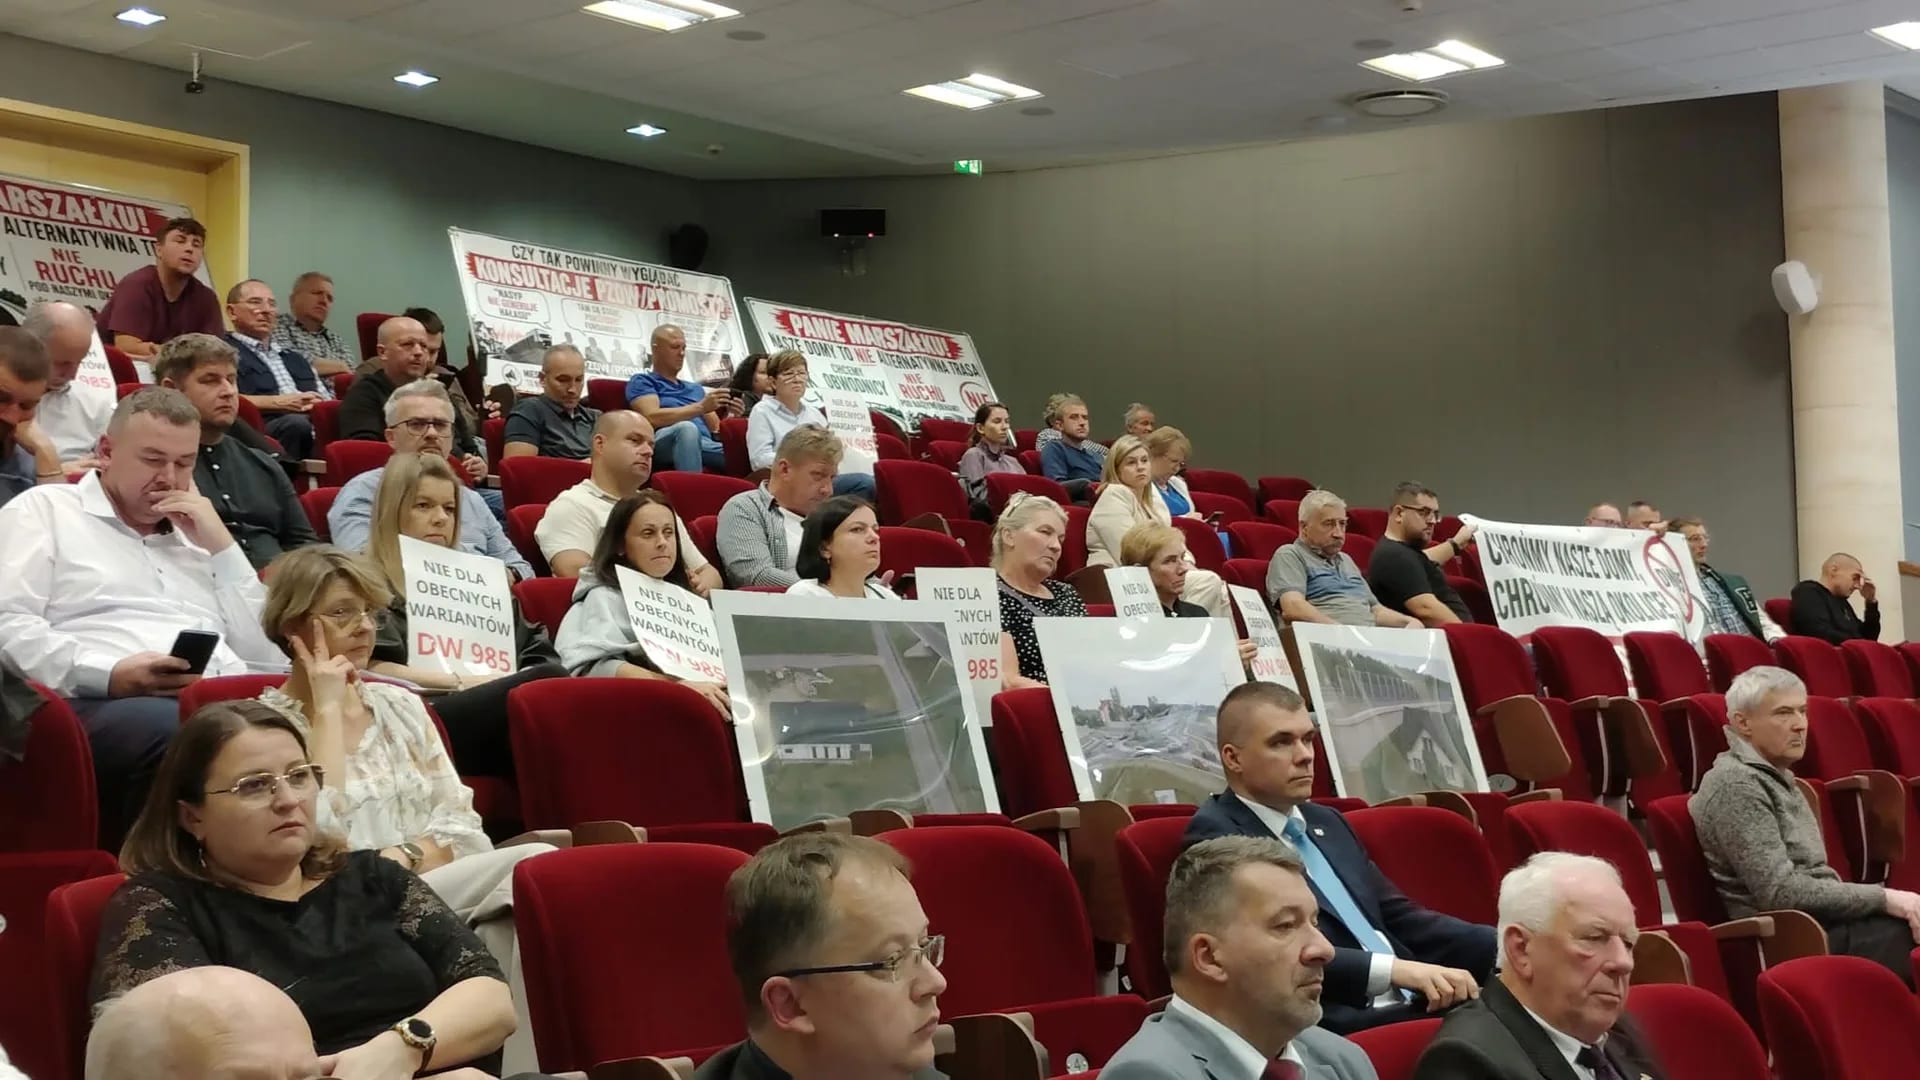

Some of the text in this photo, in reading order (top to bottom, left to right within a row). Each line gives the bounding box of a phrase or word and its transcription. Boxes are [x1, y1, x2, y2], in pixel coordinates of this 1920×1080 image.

[4, 216, 140, 255] ALTERNATYWNA
[51, 247, 84, 264] NIE
[512, 245, 535, 261] CZY
[539, 249, 562, 267] TAK
[34, 260, 118, 290] RUCHU
[474, 255, 594, 299] KONSULTACJE
[51, 284, 98, 299] NASZYMI
[788, 312, 952, 358] PANIE MARSZAŁKU!
[803, 340, 836, 359] DOMY
[837, 346, 854, 361] TO
[854, 348, 876, 363] NIE
[877, 350, 950, 375] ALTERNATYWNA
[947, 361, 981, 377] TRASA
[822, 373, 889, 396] OBWODNICY
[898, 383, 946, 402] RUCHU
[904, 373, 923, 385] NIE
[423, 559, 487, 586] NIE DLA
[1553, 542, 1601, 579] NASZE
[1594, 547, 1647, 586] DOMY,
[416, 580, 502, 611] OBECNYCH
[639, 586, 695, 615] NIE DLA
[933, 587, 982, 600] NIE DLA
[408, 601, 511, 637] WARIANTÓW
[634, 600, 709, 637] OBECNYCH
[630, 614, 720, 657] WARIANTÓW
[417, 632, 511, 673] DW 985
[967, 658, 998, 680] 985
